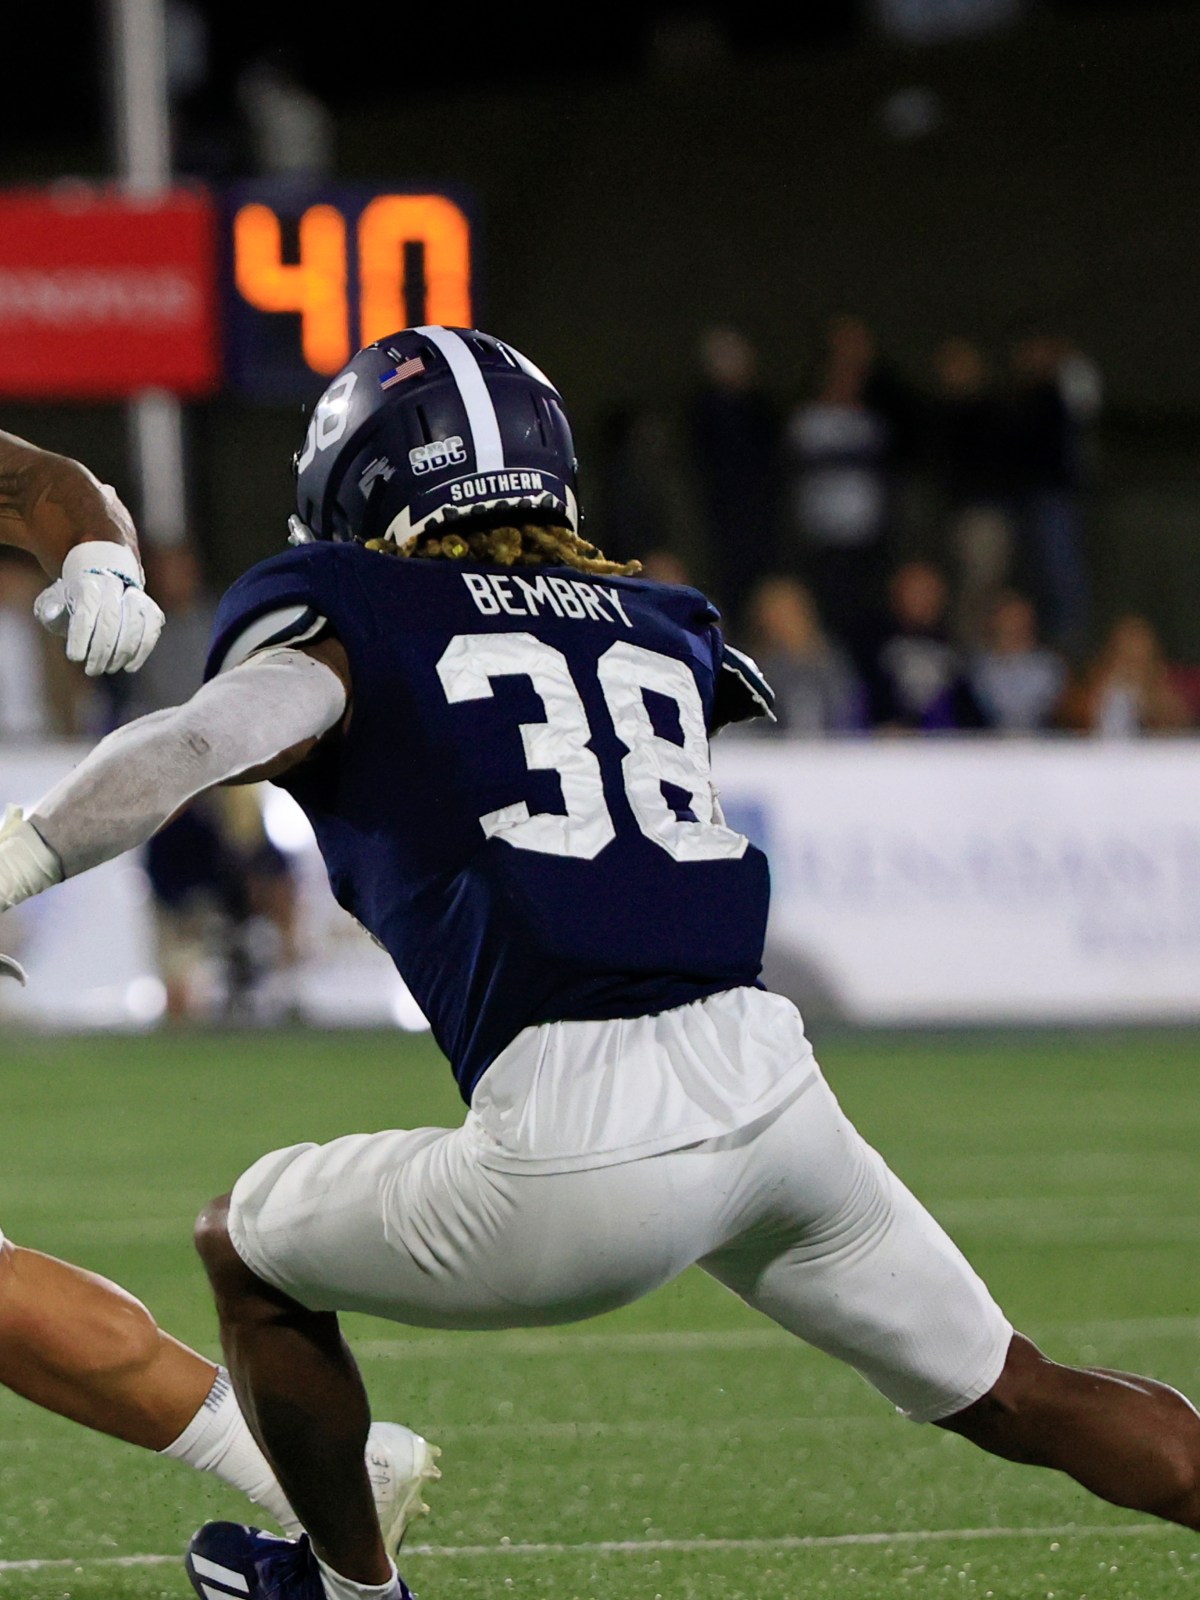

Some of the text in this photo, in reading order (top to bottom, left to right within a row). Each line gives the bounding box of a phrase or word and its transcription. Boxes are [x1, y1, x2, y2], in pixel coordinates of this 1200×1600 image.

[234, 194, 473, 376] 40
[408, 435, 467, 476] SBC
[450, 472, 543, 501] SOUTHERN
[461, 573, 634, 628] BEMBRY
[435, 632, 749, 862] 38
